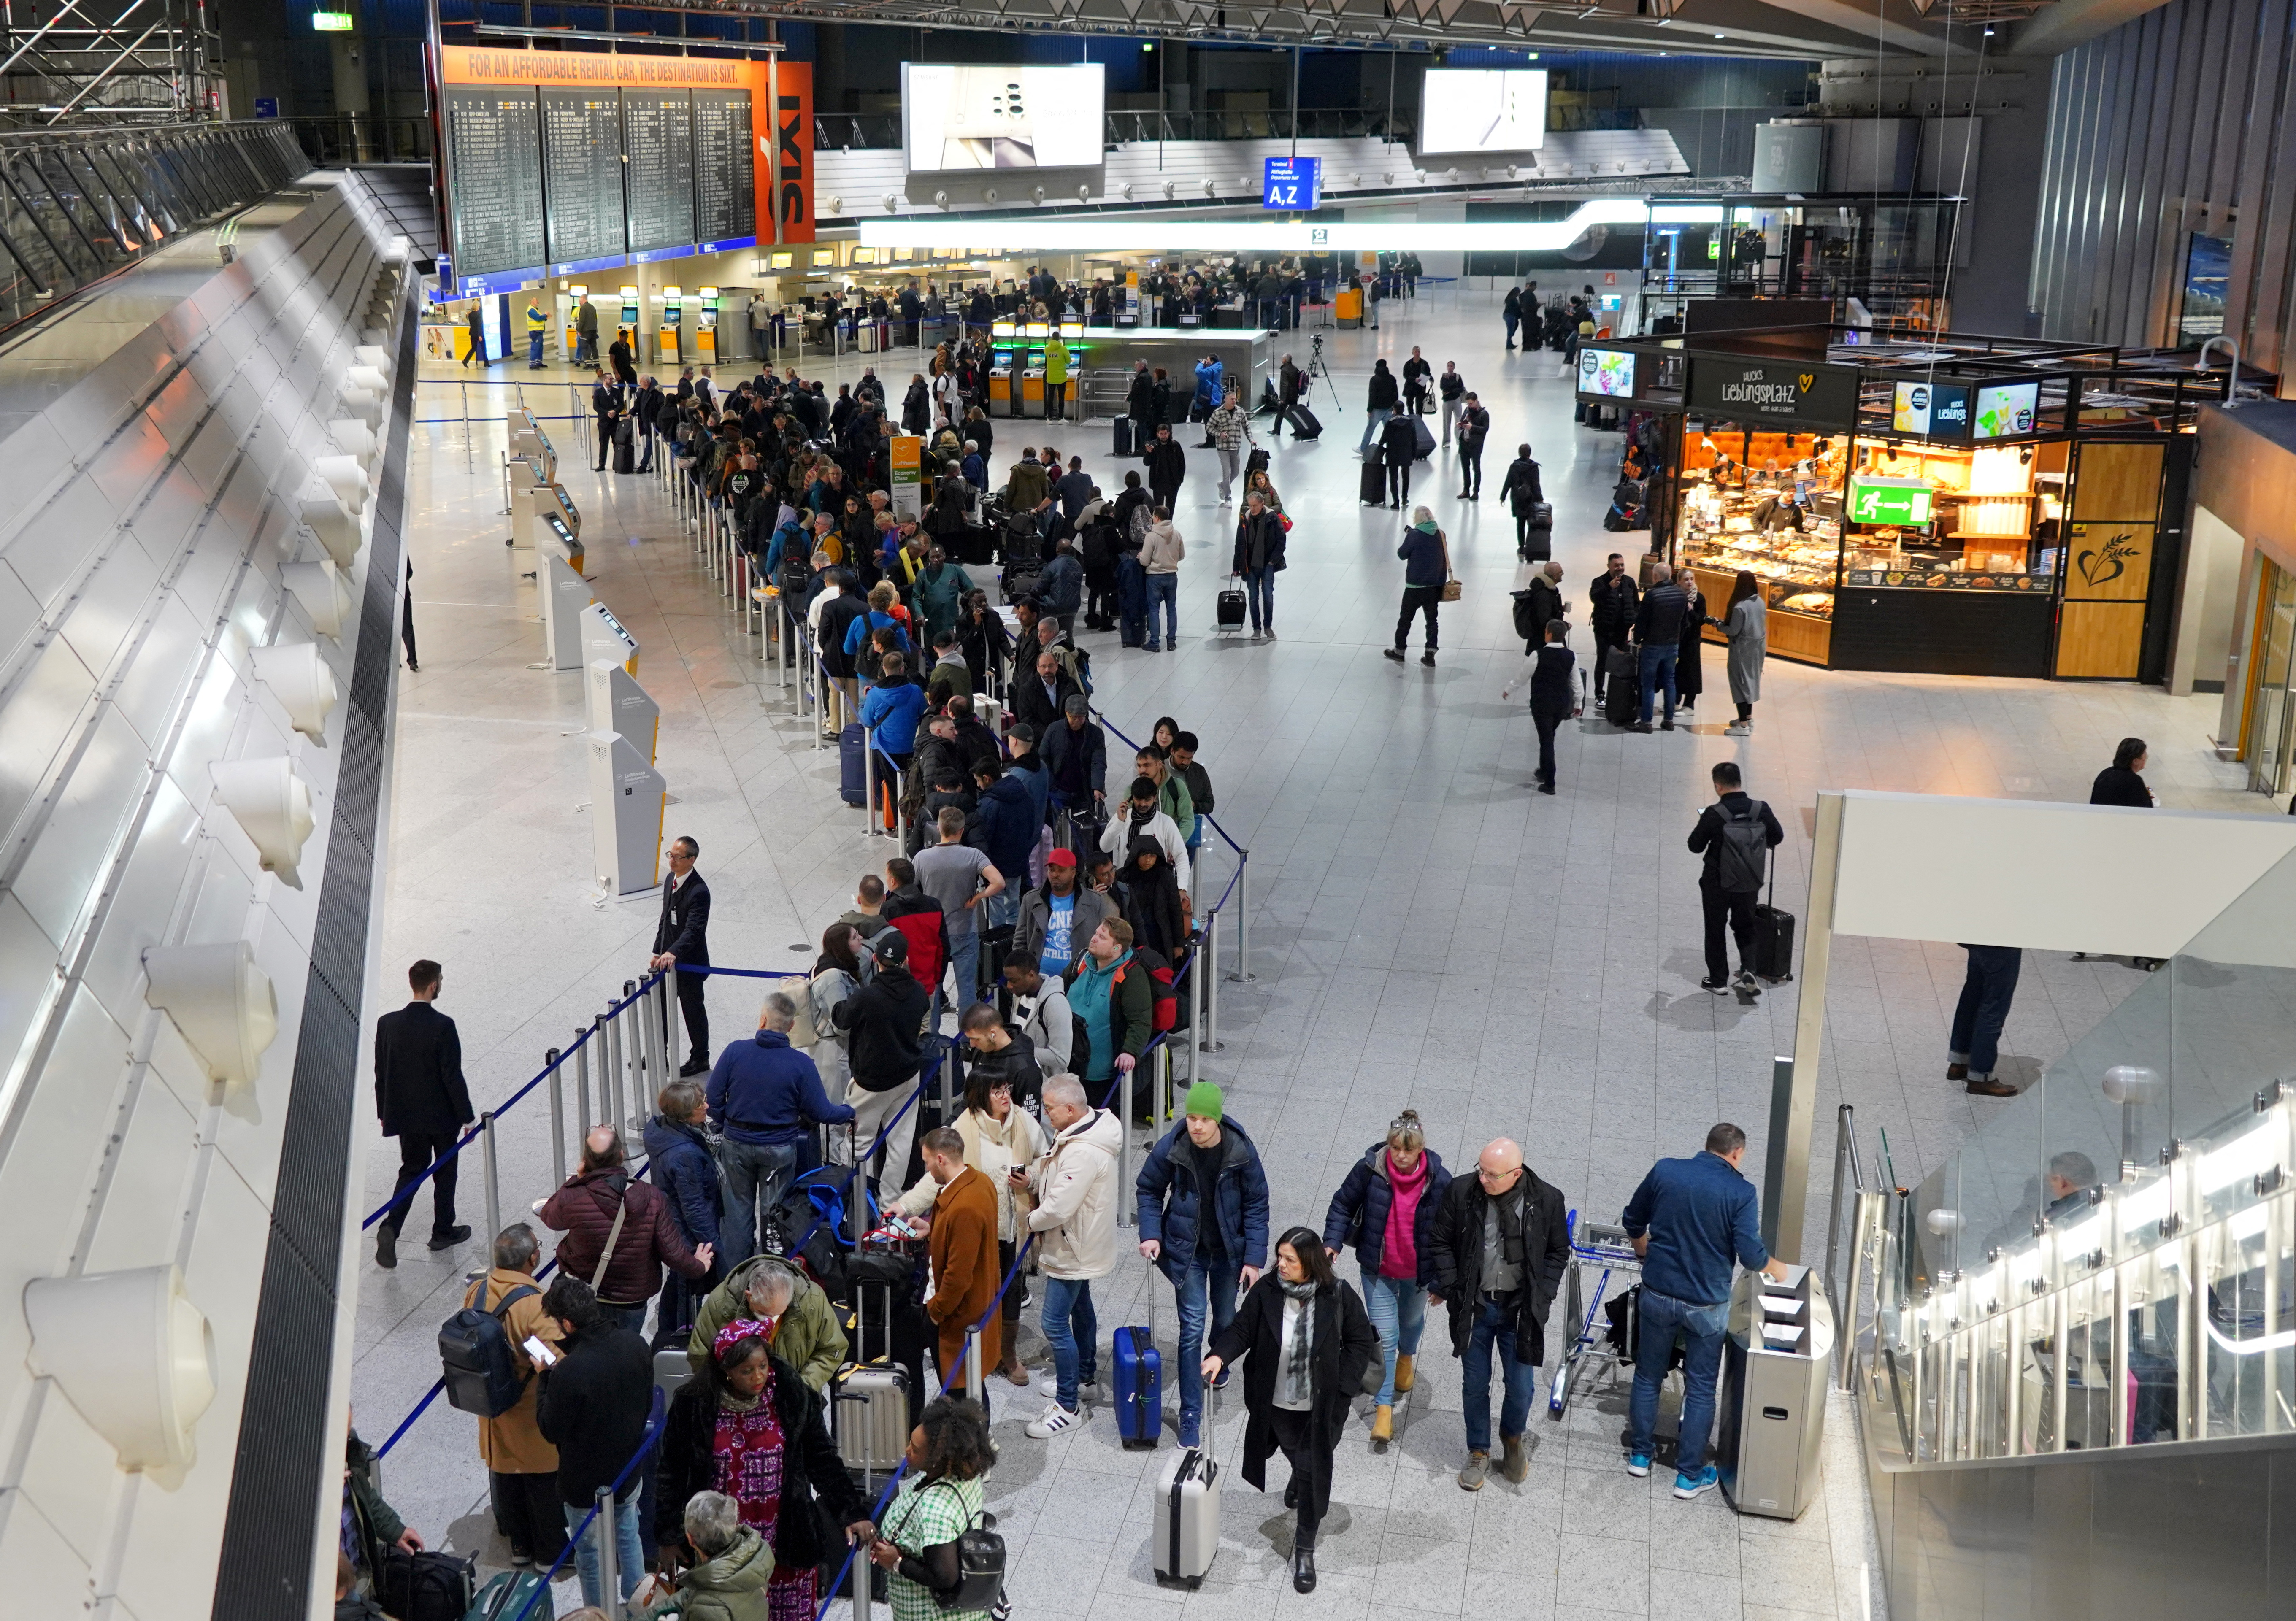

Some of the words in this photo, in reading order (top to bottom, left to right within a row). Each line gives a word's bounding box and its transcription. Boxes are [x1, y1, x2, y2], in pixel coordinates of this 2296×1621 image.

[468, 54, 492, 77] FOR
[495, 54, 509, 78] AN
[513, 56, 577, 80] AFFORDABLE
[579, 58, 614, 80] RENTAL
[617, 60, 637, 85] CAR,
[638, 61, 655, 81] THE
[657, 62, 709, 83] DESTINATION
[711, 64, 718, 83] IS
[720, 64, 738, 83] SIXT.
[1269, 186, 1297, 206] A,Z
[1743, 370, 1763, 382] HUCKS
